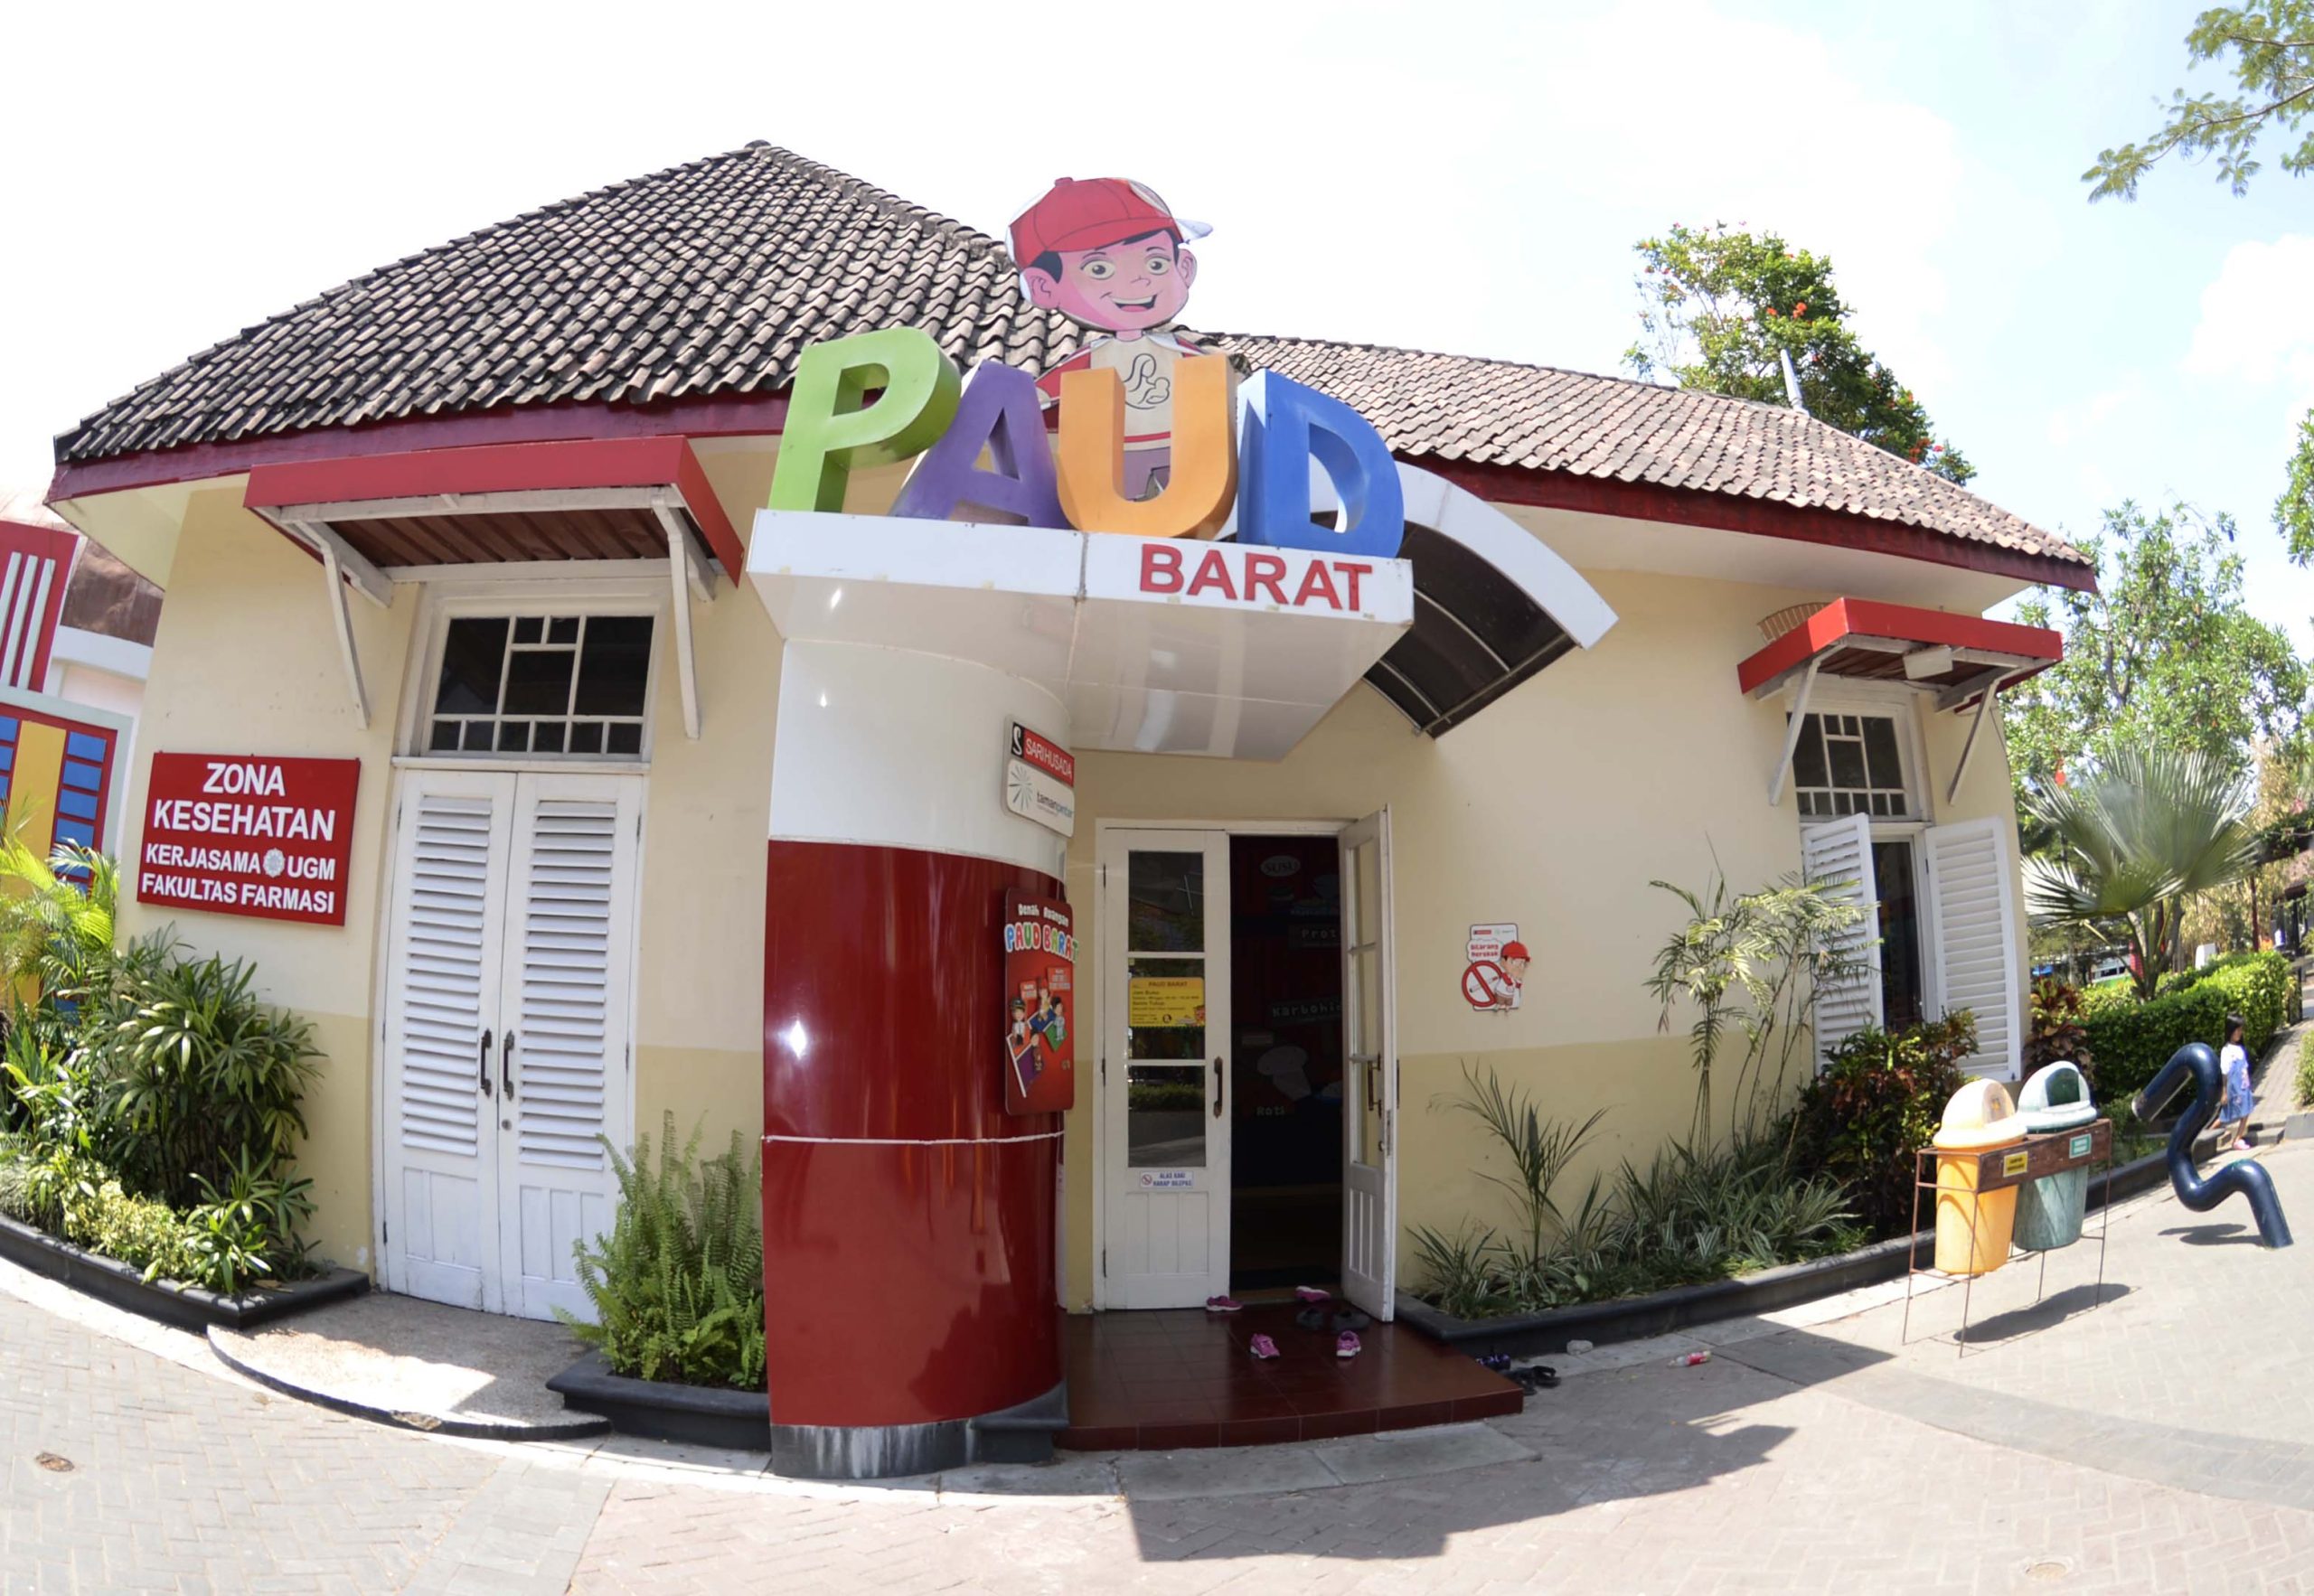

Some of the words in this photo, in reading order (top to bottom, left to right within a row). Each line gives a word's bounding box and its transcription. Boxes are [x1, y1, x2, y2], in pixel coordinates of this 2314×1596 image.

[767, 327, 1405, 559] PAUD
[1139, 543, 1372, 613] BARAT
[1025, 737, 1073, 779] SARIHUSADA
[202, 762, 287, 797] ZONA
[153, 799, 336, 841] KESEHATAN
[145, 842, 261, 875] KERJASAMA
[287, 855, 336, 881] UGM
[141, 872, 238, 904] FAKULTAS
[240, 883, 335, 914] FARMASI
[1004, 921, 1041, 953] PAUD
[1042, 924, 1079, 964] BARAT
